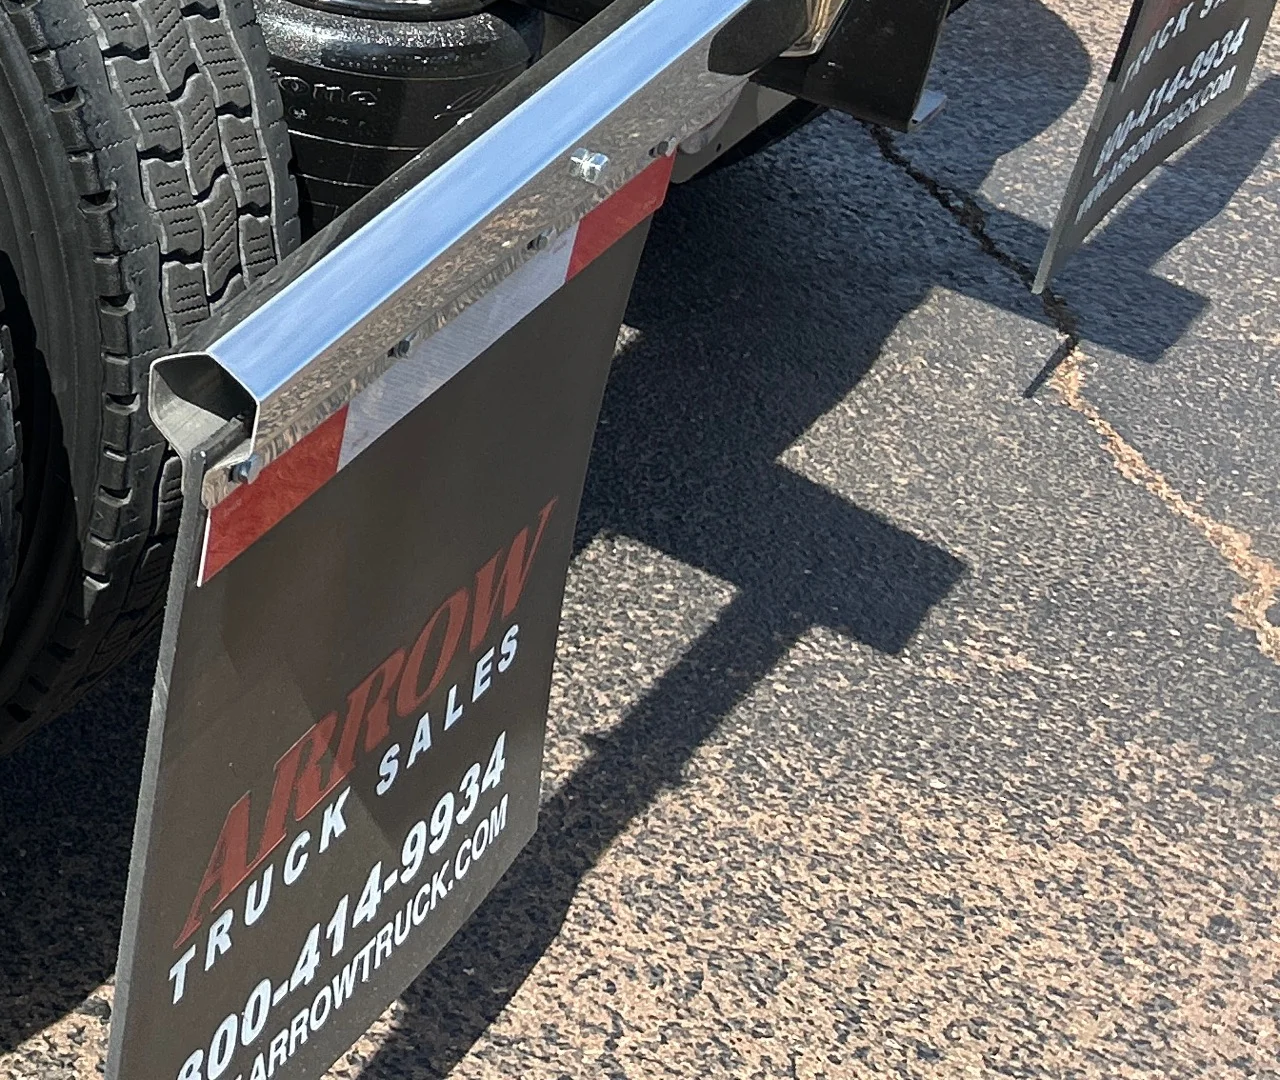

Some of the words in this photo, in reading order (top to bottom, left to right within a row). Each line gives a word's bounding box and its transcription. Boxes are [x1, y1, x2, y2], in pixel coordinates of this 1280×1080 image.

[1120, 0, 1195, 92] TRUCK
[167, 786, 351, 1005] TRUCK
[375, 623, 519, 797] SALES
[173, 495, 558, 949] ARROW
